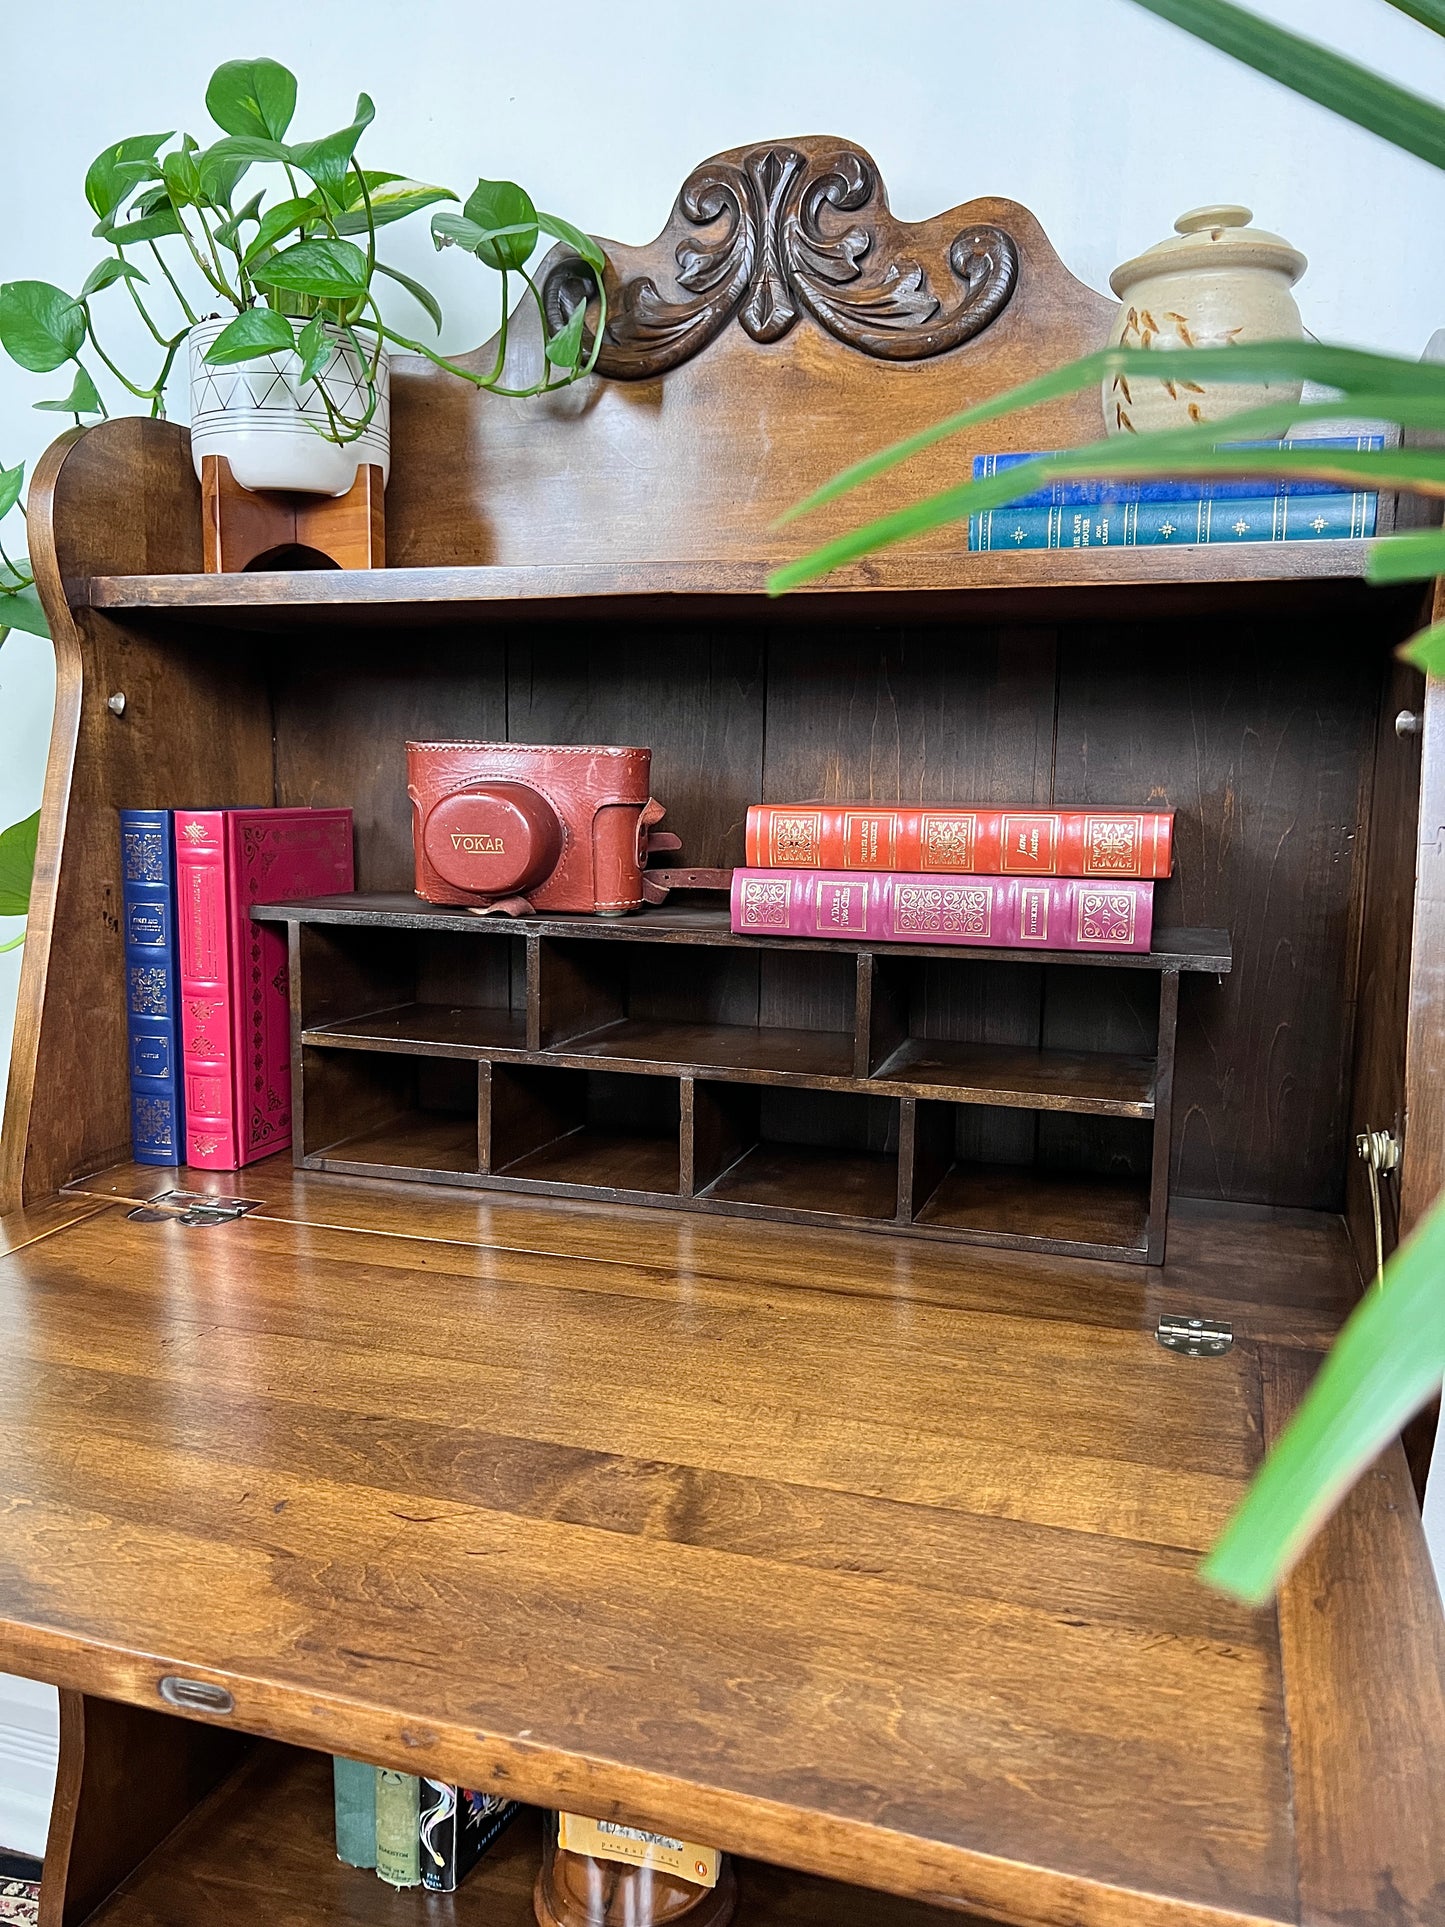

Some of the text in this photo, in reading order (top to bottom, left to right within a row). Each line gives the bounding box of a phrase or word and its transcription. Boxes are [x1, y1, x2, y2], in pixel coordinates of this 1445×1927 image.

[1073, 513, 1082, 534] SAFE
[1082, 518, 1090, 546] HOUSE
[450, 833, 505, 854] VOKAR
[1016, 833, 1028, 855] Jane
[1028, 828, 1039, 861] Austen
[1030, 895, 1039, 933] DICKENS
